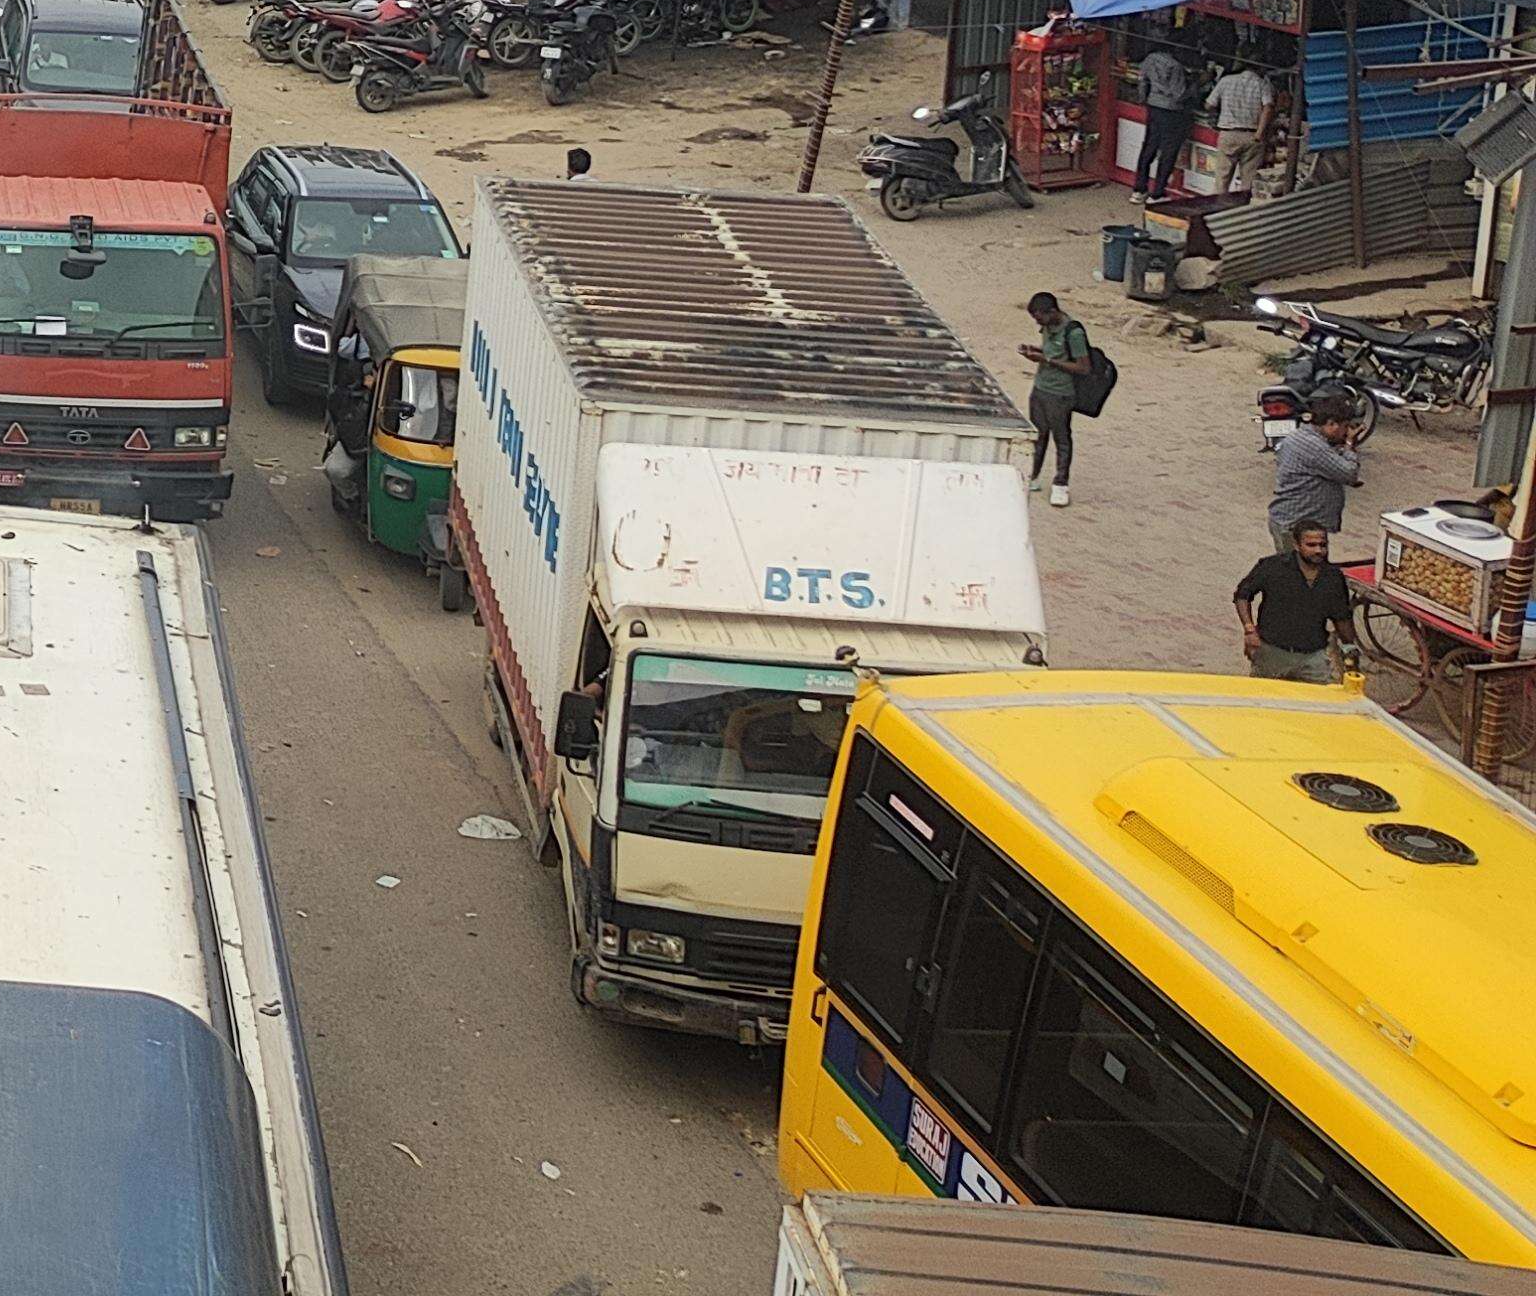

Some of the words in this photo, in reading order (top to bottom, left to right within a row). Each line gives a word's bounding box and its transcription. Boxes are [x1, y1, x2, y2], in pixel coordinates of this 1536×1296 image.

[59, 406, 99, 418] TATA
[763, 566, 885, 609] B.T.S.
[912, 1102, 949, 1157] SURAJ
